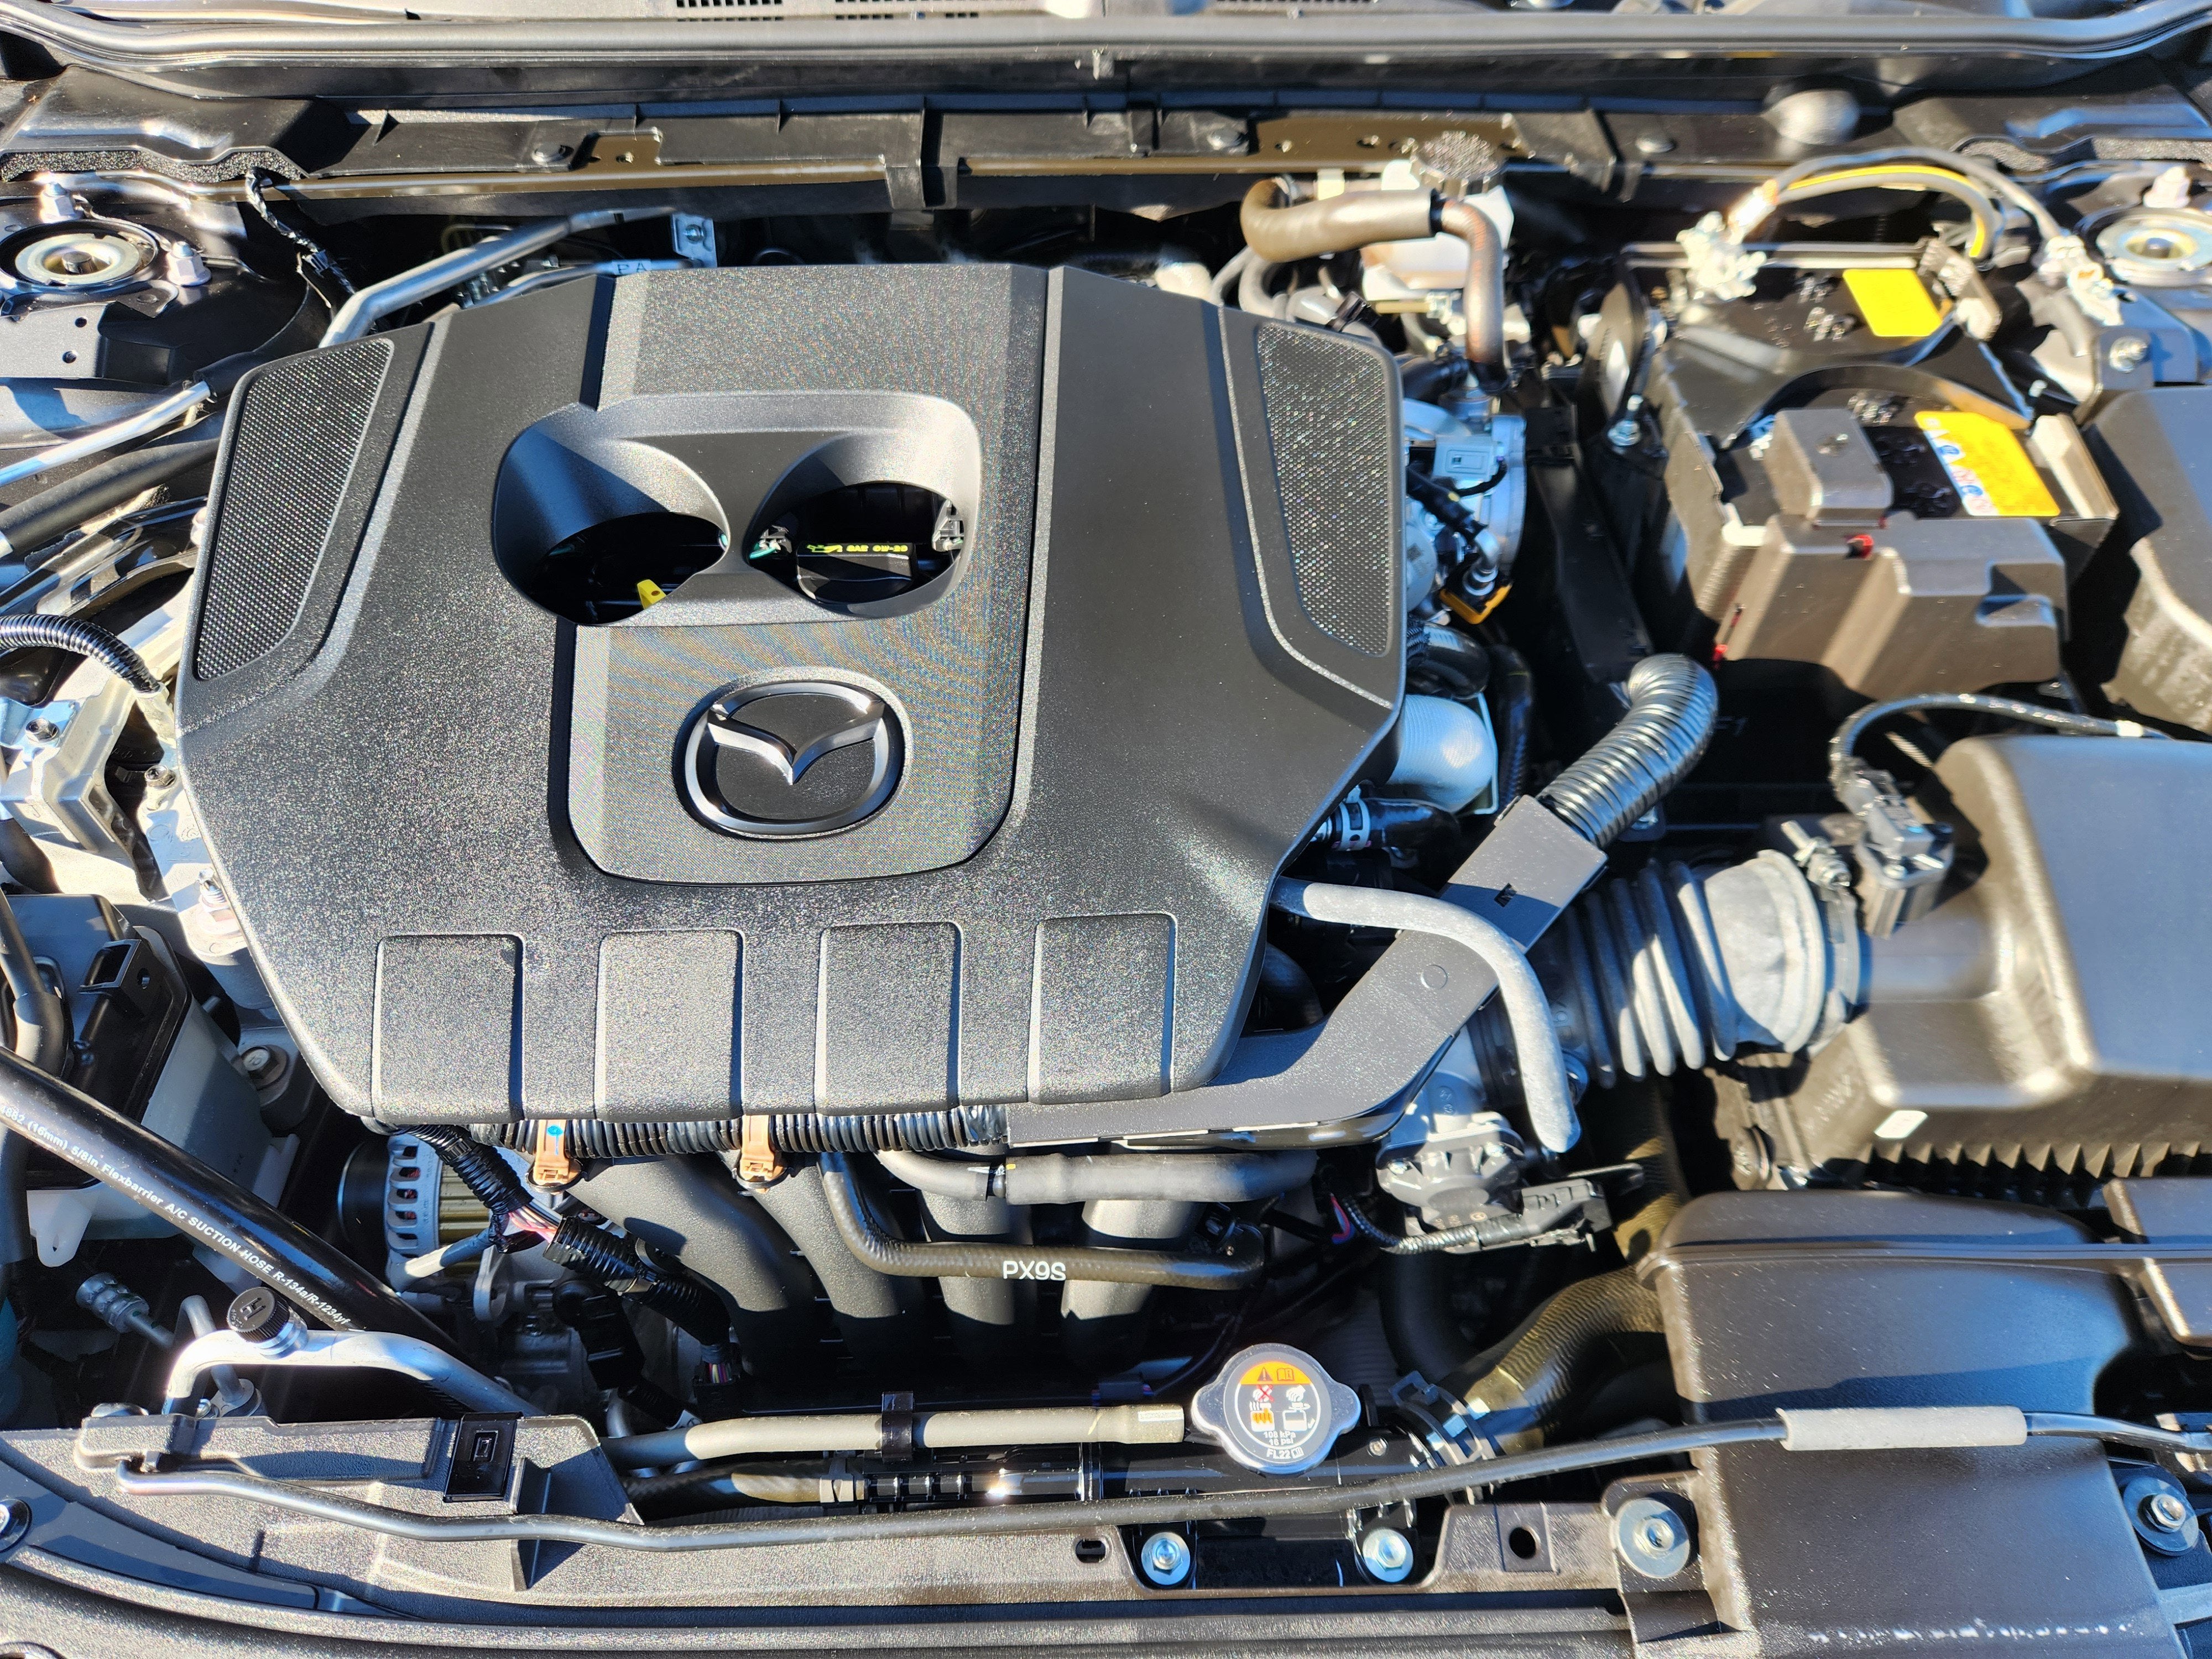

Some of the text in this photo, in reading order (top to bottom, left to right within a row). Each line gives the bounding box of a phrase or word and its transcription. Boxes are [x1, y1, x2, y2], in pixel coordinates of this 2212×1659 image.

[28, 1120, 67, 1150] (16mm)
[101, 1163, 164, 1205] Flexbarrier
[165, 1203, 187, 1219] A/C
[188, 1217, 242, 1253] SUCTION
[240, 1249, 275, 1274] HOSE
[273, 1271, 351, 1324] R-134a/R-1234yf
[1003, 1260, 1066, 1281] PX9S
[1279, 1430, 1296, 1438] kPa
[1266, 1448, 1291, 1459] FL22
